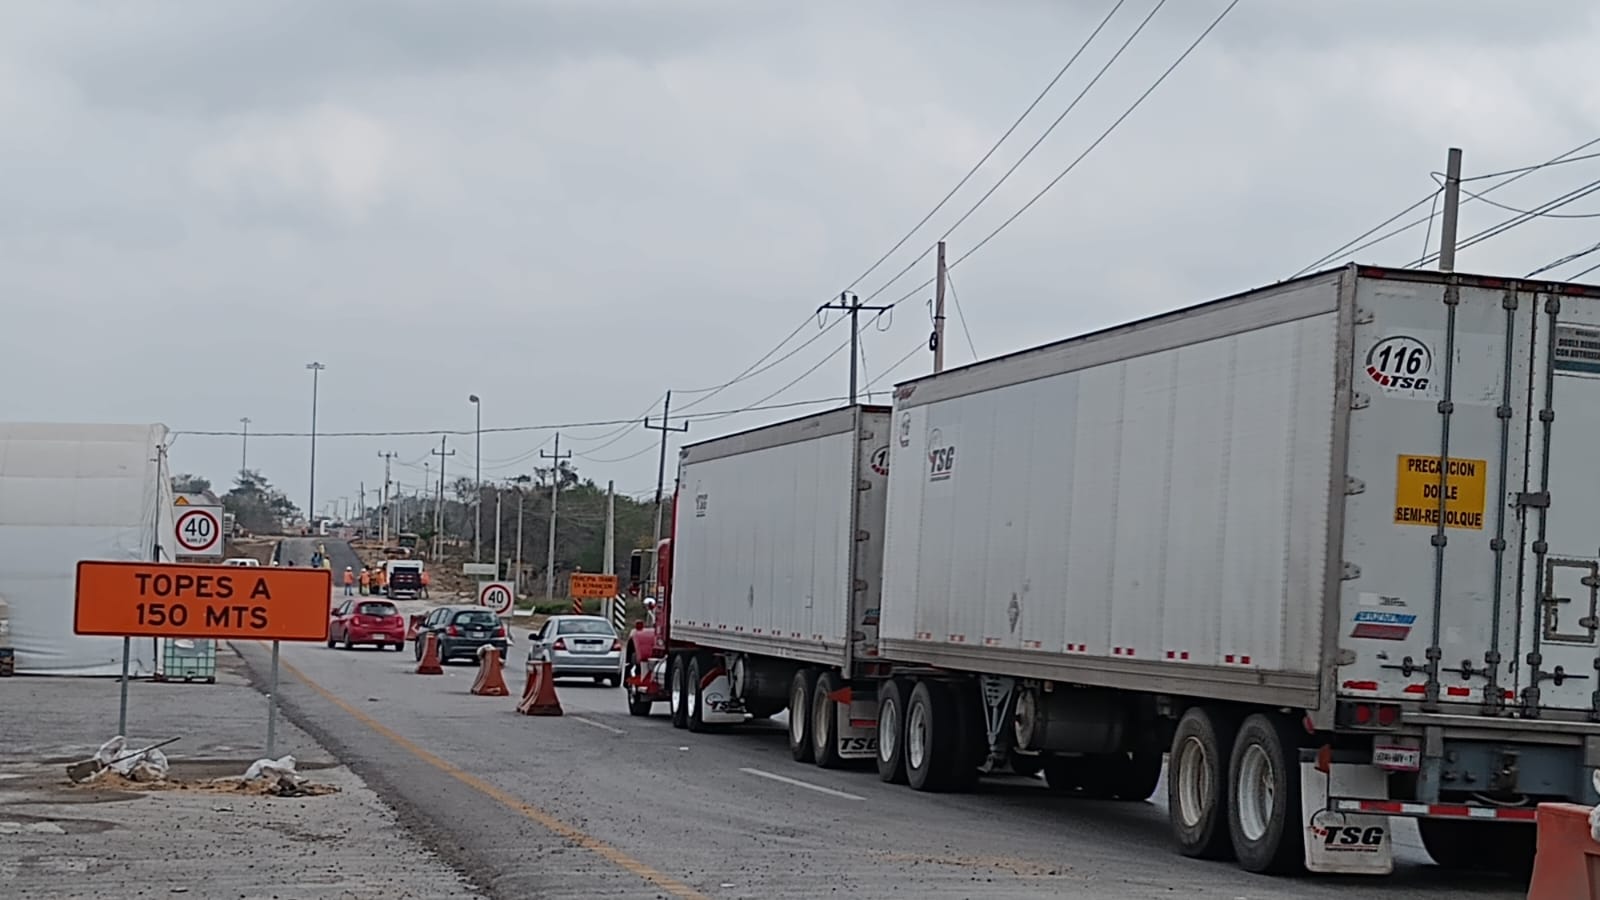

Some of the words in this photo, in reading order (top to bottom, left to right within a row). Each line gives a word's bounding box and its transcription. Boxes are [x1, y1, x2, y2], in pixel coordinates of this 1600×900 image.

[1379, 345, 1423, 374] 116
[1390, 375, 1429, 390] TSG
[930, 446, 955, 473] TSG
[1408, 459, 1475, 477] PRECACION
[185, 517, 210, 537] 40
[1395, 507, 1482, 527] SEMI-REOLQUE
[135, 573, 234, 599] TOPES
[250, 577, 271, 600] A
[488, 590, 504, 604] 40
[136, 602, 188, 627] 150
[205, 604, 268, 629] MTS
[1324, 826, 1385, 845] TSG
